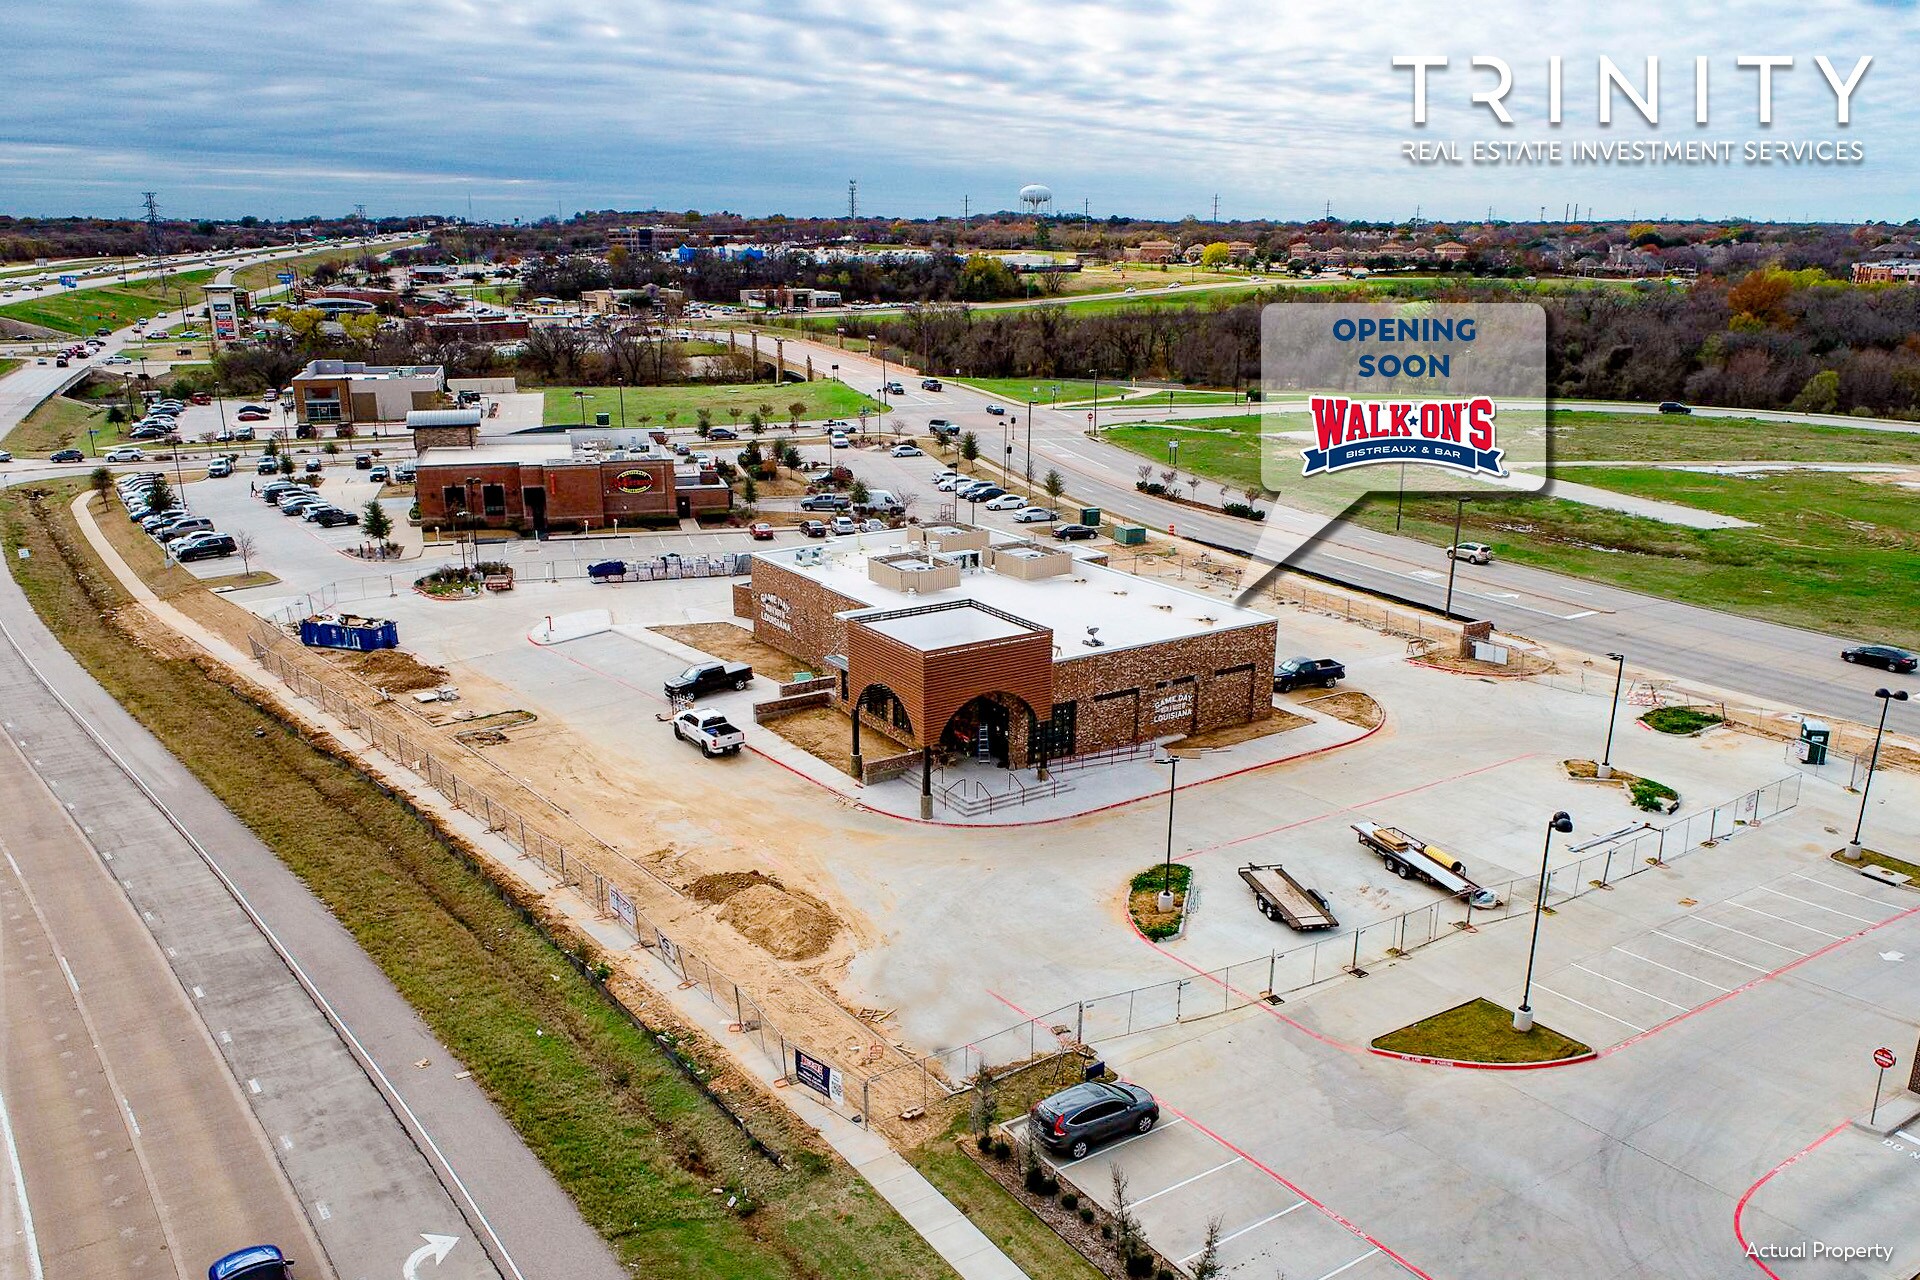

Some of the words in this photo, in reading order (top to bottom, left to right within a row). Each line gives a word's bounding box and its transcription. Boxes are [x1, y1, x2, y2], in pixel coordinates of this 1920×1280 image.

[760, 611, 792, 633] LOUISIANA
[1154, 695, 1178, 709] GAME
[1178, 694, 1193, 703] DAY
[1153, 708, 1193, 723] LOUISIANA
[1881, 1139, 1905, 1152] DO
